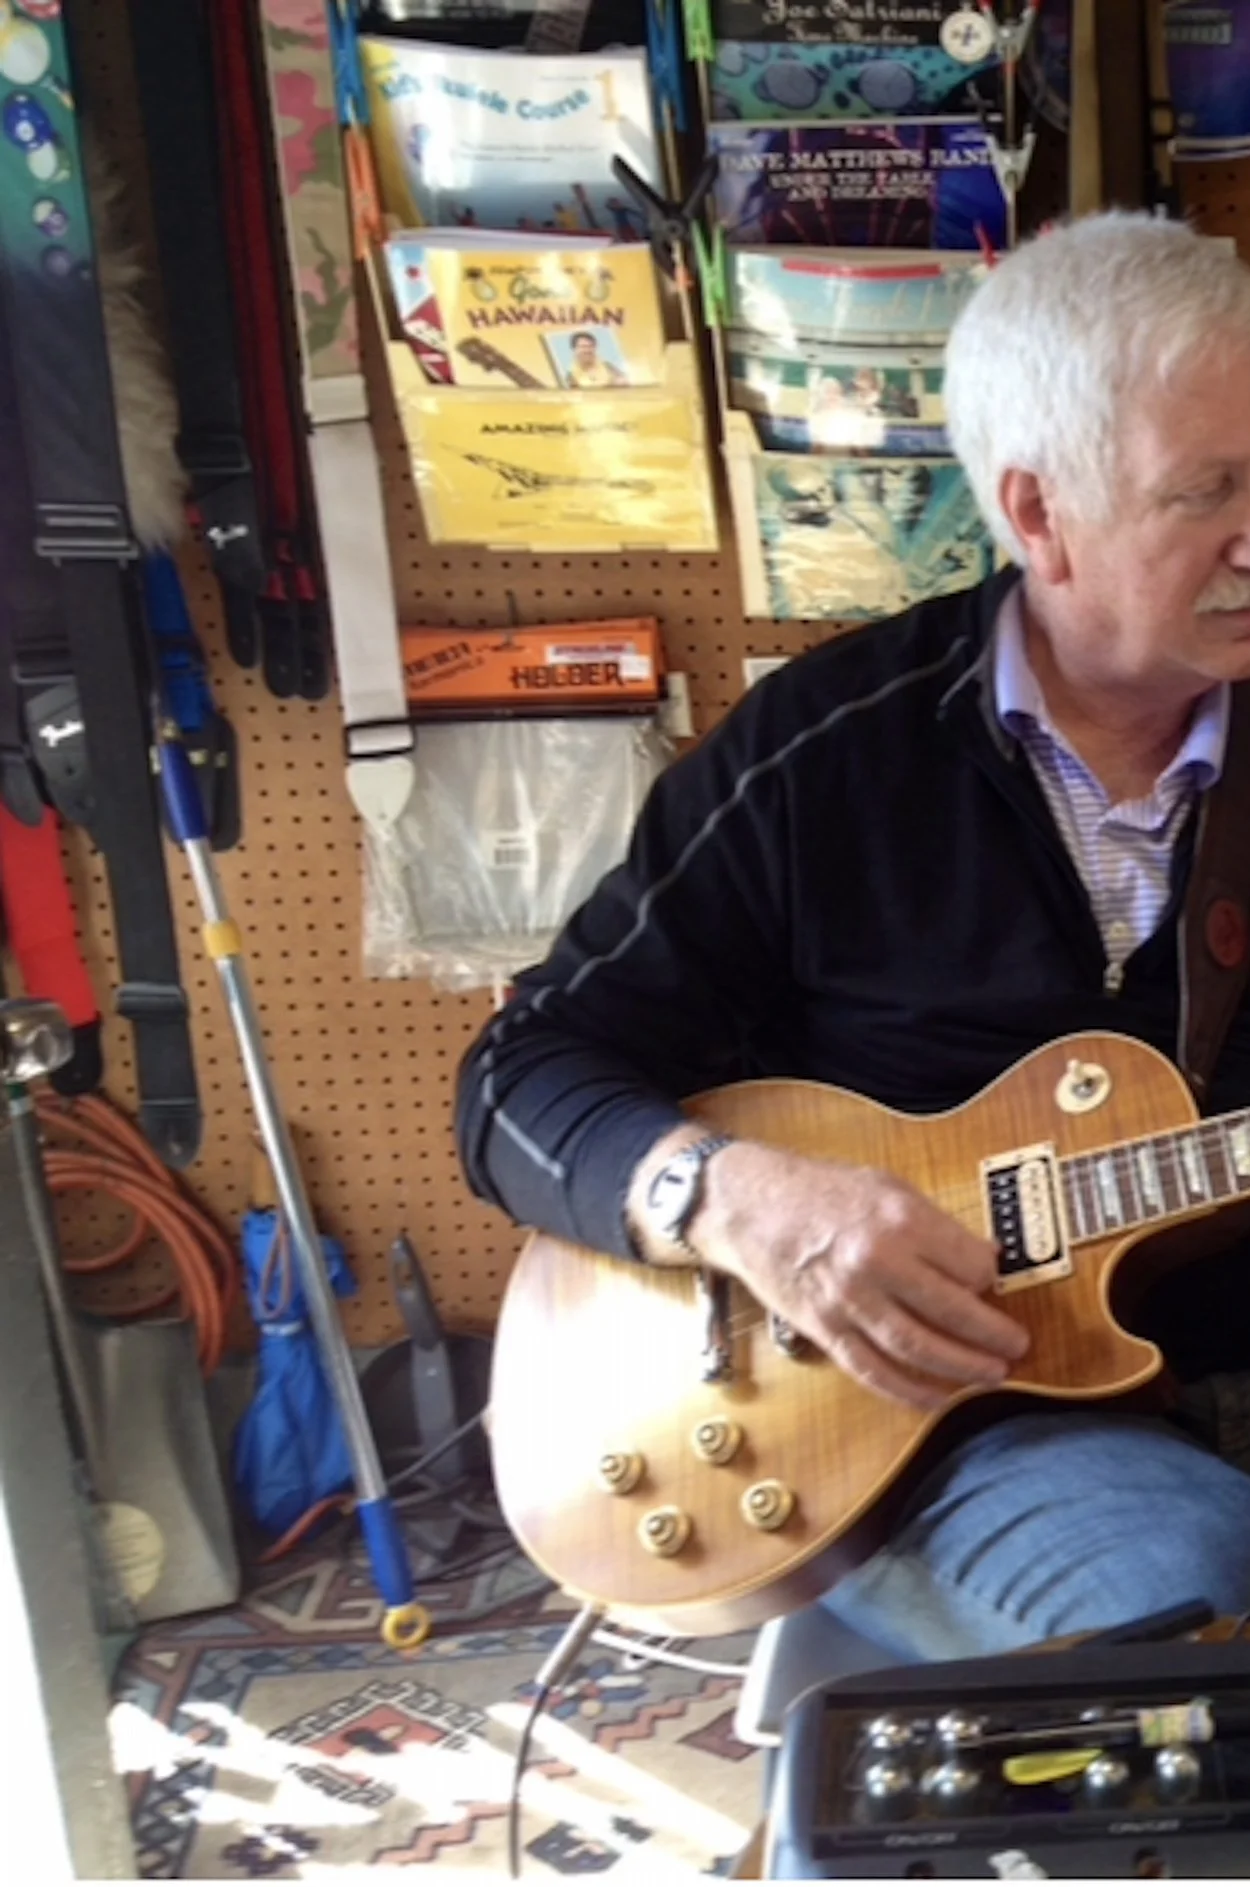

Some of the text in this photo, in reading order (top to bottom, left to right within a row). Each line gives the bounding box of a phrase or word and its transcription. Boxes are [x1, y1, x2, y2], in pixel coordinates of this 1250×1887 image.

[762, 0, 816, 24] Joe
[720, 152, 784, 173] DAVE
[791, 149, 924, 170] MATTHEWS
